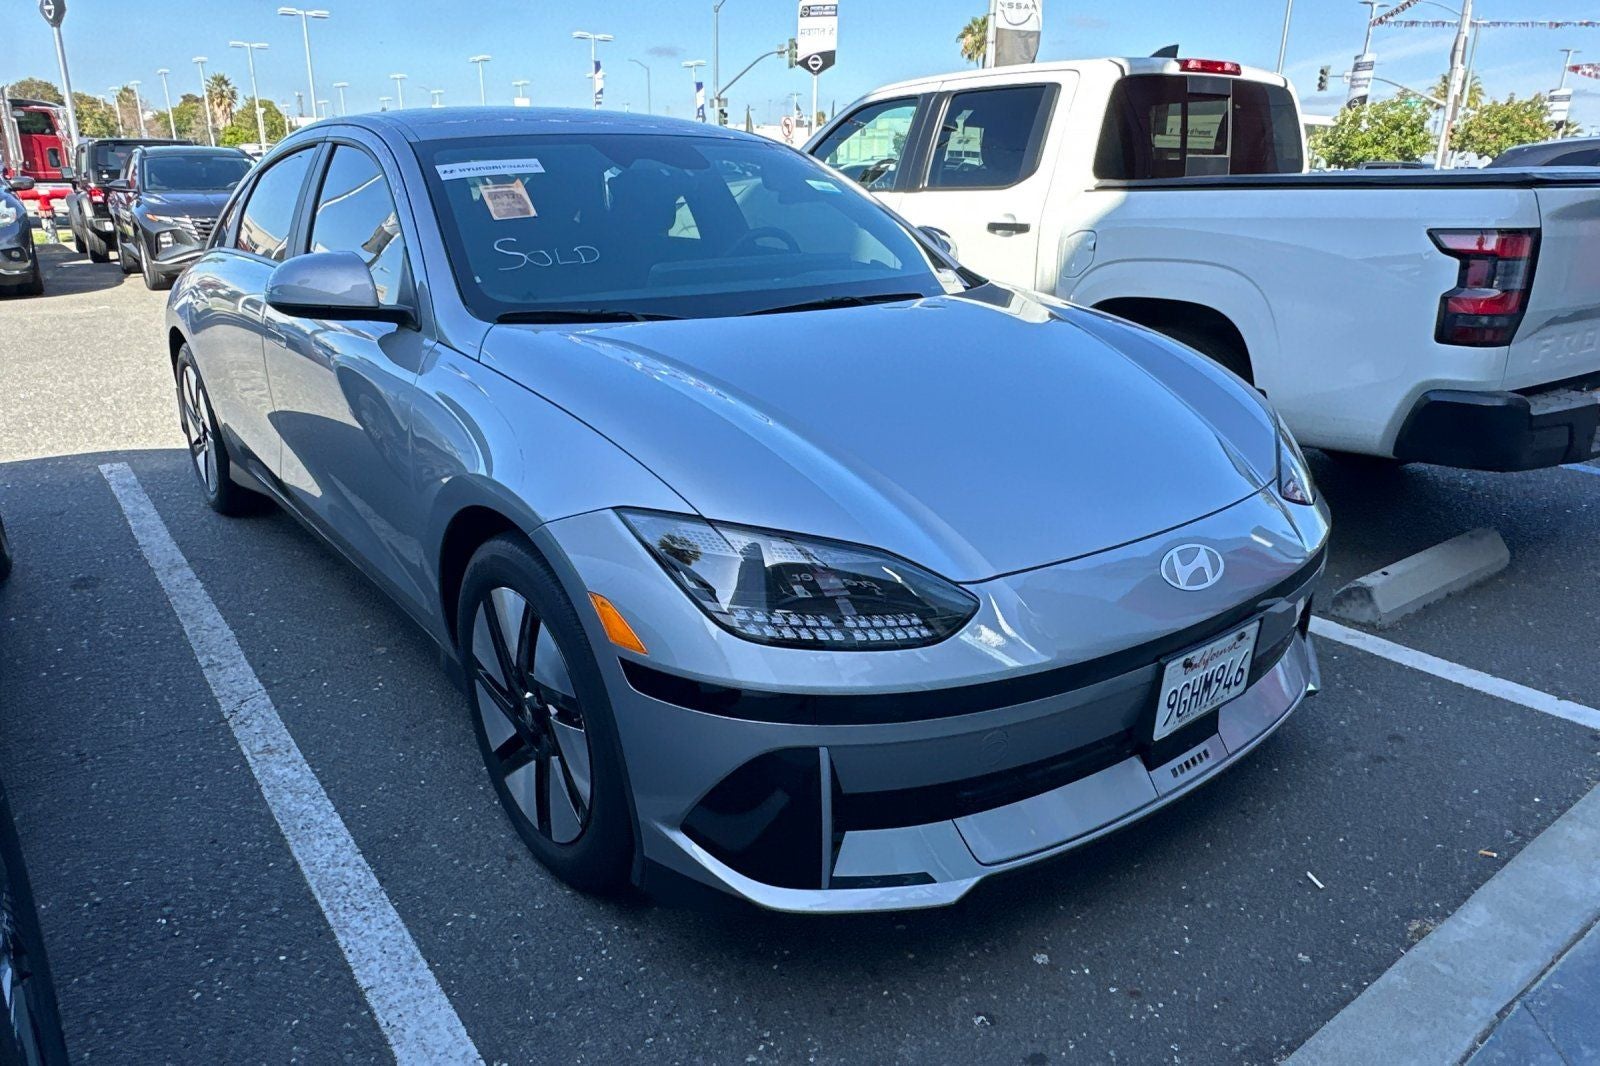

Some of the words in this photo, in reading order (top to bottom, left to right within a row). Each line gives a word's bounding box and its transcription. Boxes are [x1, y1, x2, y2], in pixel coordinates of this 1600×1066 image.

[999, 1, 1037, 10] NSSAN
[494, 238, 600, 270] SOLD
[1163, 650, 1249, 727] 9GHM946
